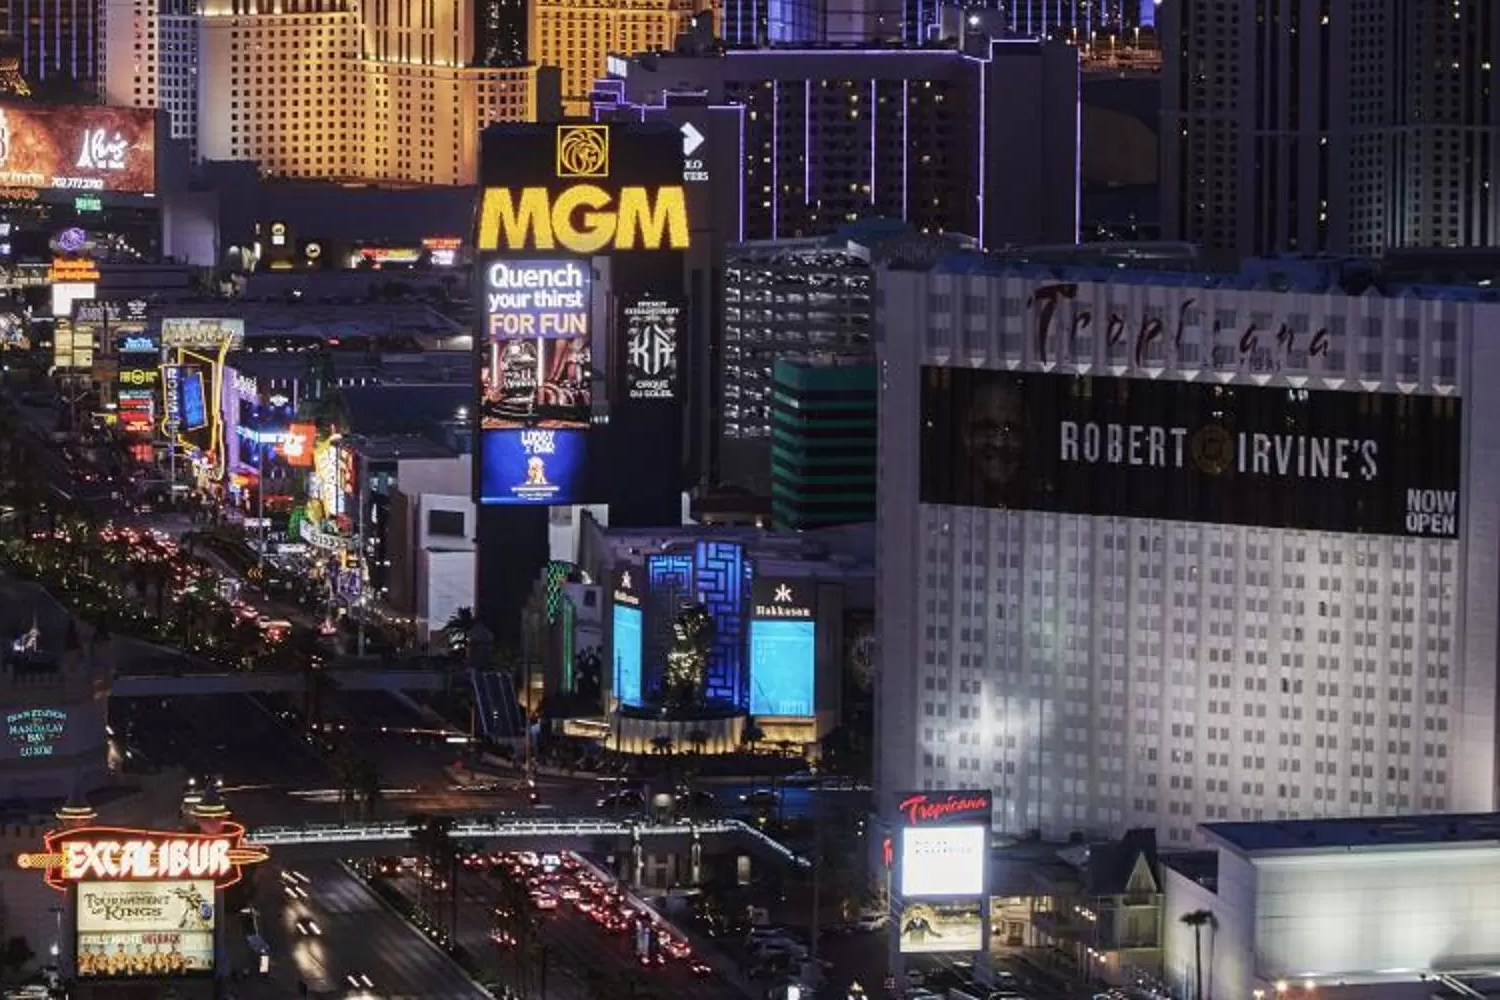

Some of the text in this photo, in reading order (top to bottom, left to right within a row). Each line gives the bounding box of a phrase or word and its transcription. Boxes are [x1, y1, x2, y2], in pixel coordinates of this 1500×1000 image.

[479, 183, 690, 253] MGM
[489, 263, 583, 289] Quench
[488, 290, 584, 312] your thirst
[489, 314, 588, 335] FOR FUN
[1028, 284, 1331, 366] Tropiana
[1060, 420, 1379, 481] ROBERT IRVINE'S
[1407, 487, 1457, 514] NOW
[1406, 512, 1456, 535] OPEN
[756, 604, 812, 617] Hakkasan
[900, 795, 988, 825] Tropicana
[64, 839, 232, 879] EXCALIBUR
[83, 892, 171, 907] TOURNAMENT
[104, 904, 163, 921] KINGS
